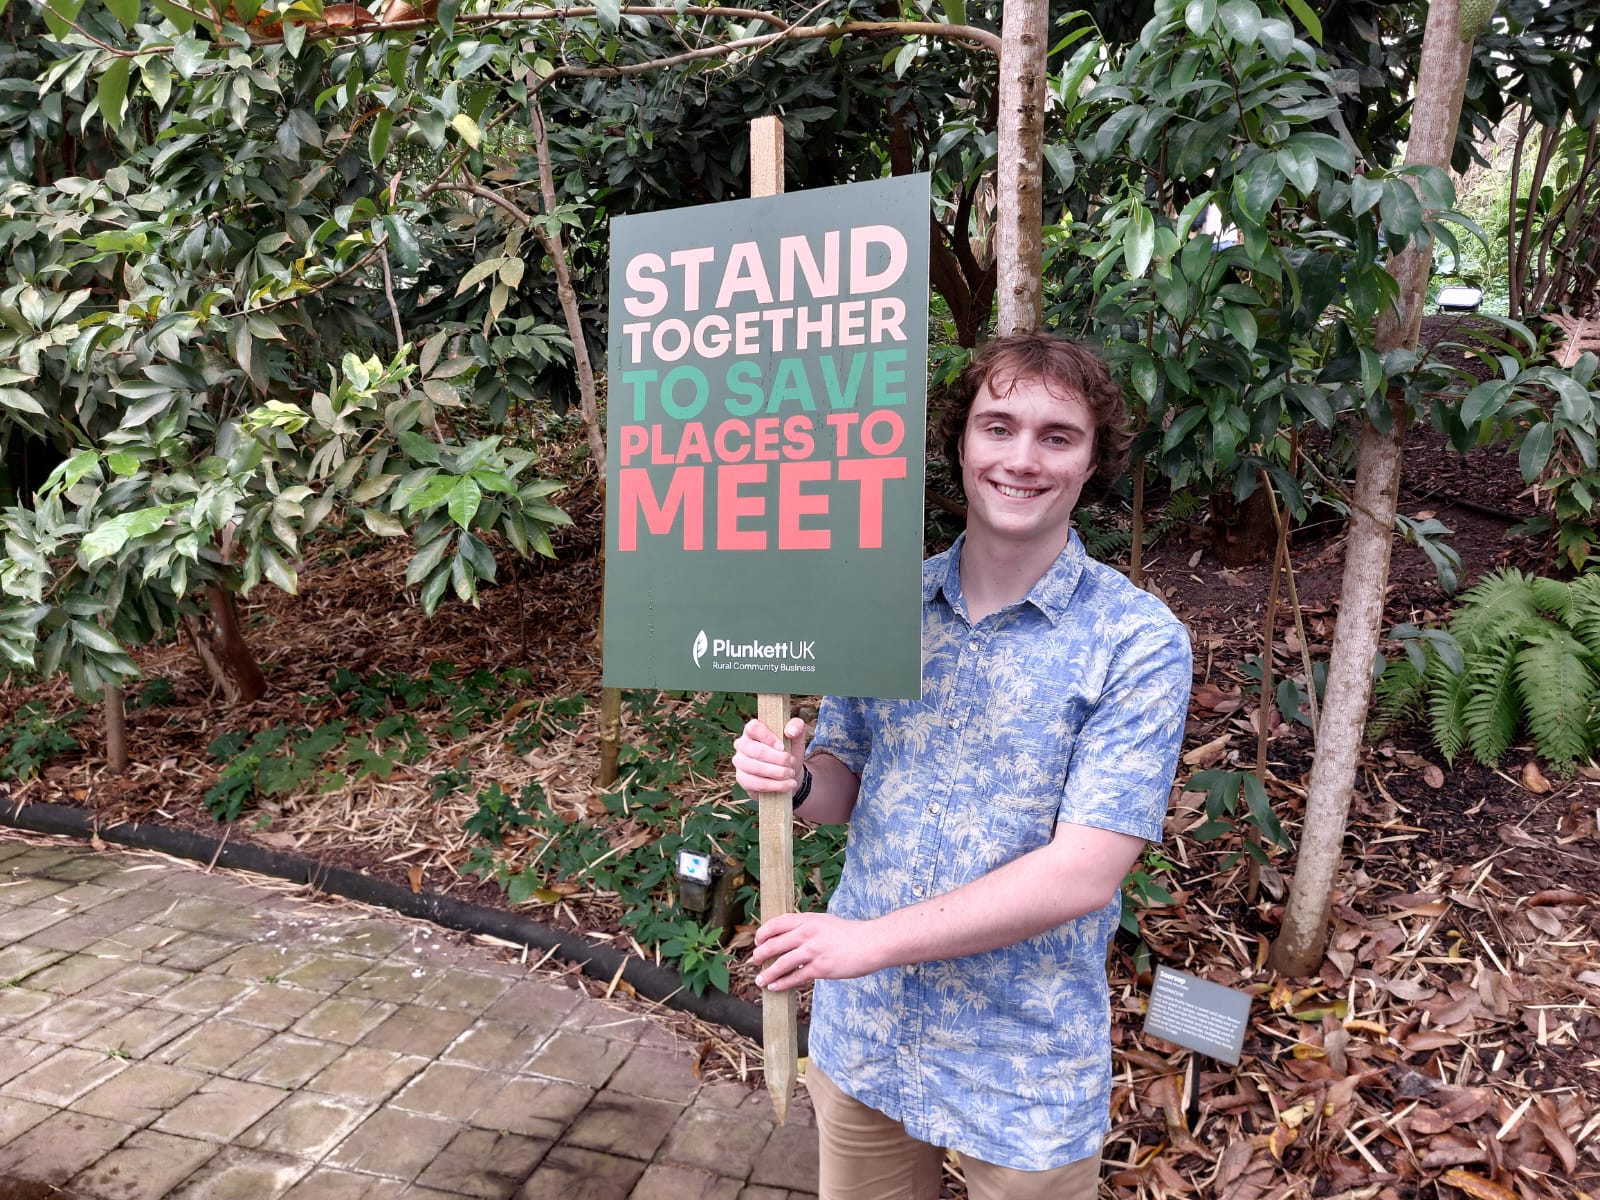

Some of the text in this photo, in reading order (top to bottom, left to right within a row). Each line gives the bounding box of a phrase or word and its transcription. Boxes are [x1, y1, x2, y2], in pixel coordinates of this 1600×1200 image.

[623, 224, 908, 318] STAND
[622, 297, 908, 364] TOGETHER
[622, 349, 908, 422] TO SAVE
[620, 409, 905, 466] PLACES TO
[618, 457, 907, 551] MEET
[712, 661, 816, 673] Rural Community Business
